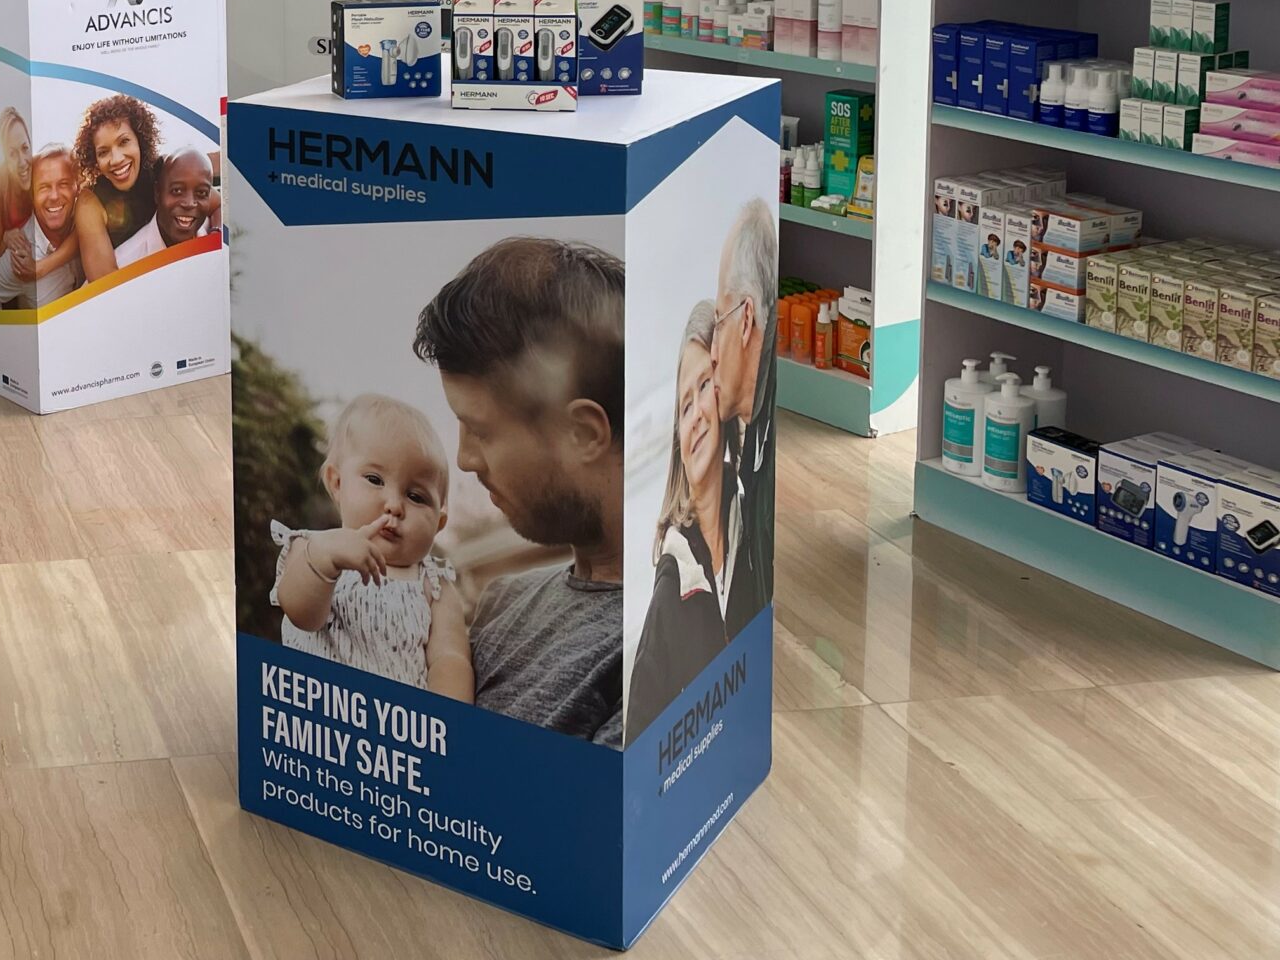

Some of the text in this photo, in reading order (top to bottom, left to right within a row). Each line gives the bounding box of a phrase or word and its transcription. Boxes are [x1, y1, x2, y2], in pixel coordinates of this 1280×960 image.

[85, 6, 173, 33] ADVANCIS
[72, 42, 95, 51] ENJOY
[96, 40, 110, 49] LIFE
[112, 36, 144, 47] WITHOUT
[145, 31, 187, 43] LIMITATIONS
[831, 101, 851, 117] SOS
[831, 116, 851, 127] AFTER
[268, 127, 494, 189] HERMANN
[281, 172, 427, 204] medical supplies
[1087, 271, 1114, 287] Benlif
[1120, 279, 1148, 295] Benlif
[1152, 288, 1181, 304] Benlif
[1185, 295, 1215, 311] Benlif
[51, 371, 140, 397] www.advancispharma.com
[261, 662, 447, 757] KEEPING YOUR
[658, 652, 747, 776] HERMANN
[262, 705, 430, 796] FAMILY SAFE.
[663, 719, 723, 793] medical supplies
[262, 746, 503, 855] With the high quality
[263, 779, 537, 895] products for home use.
